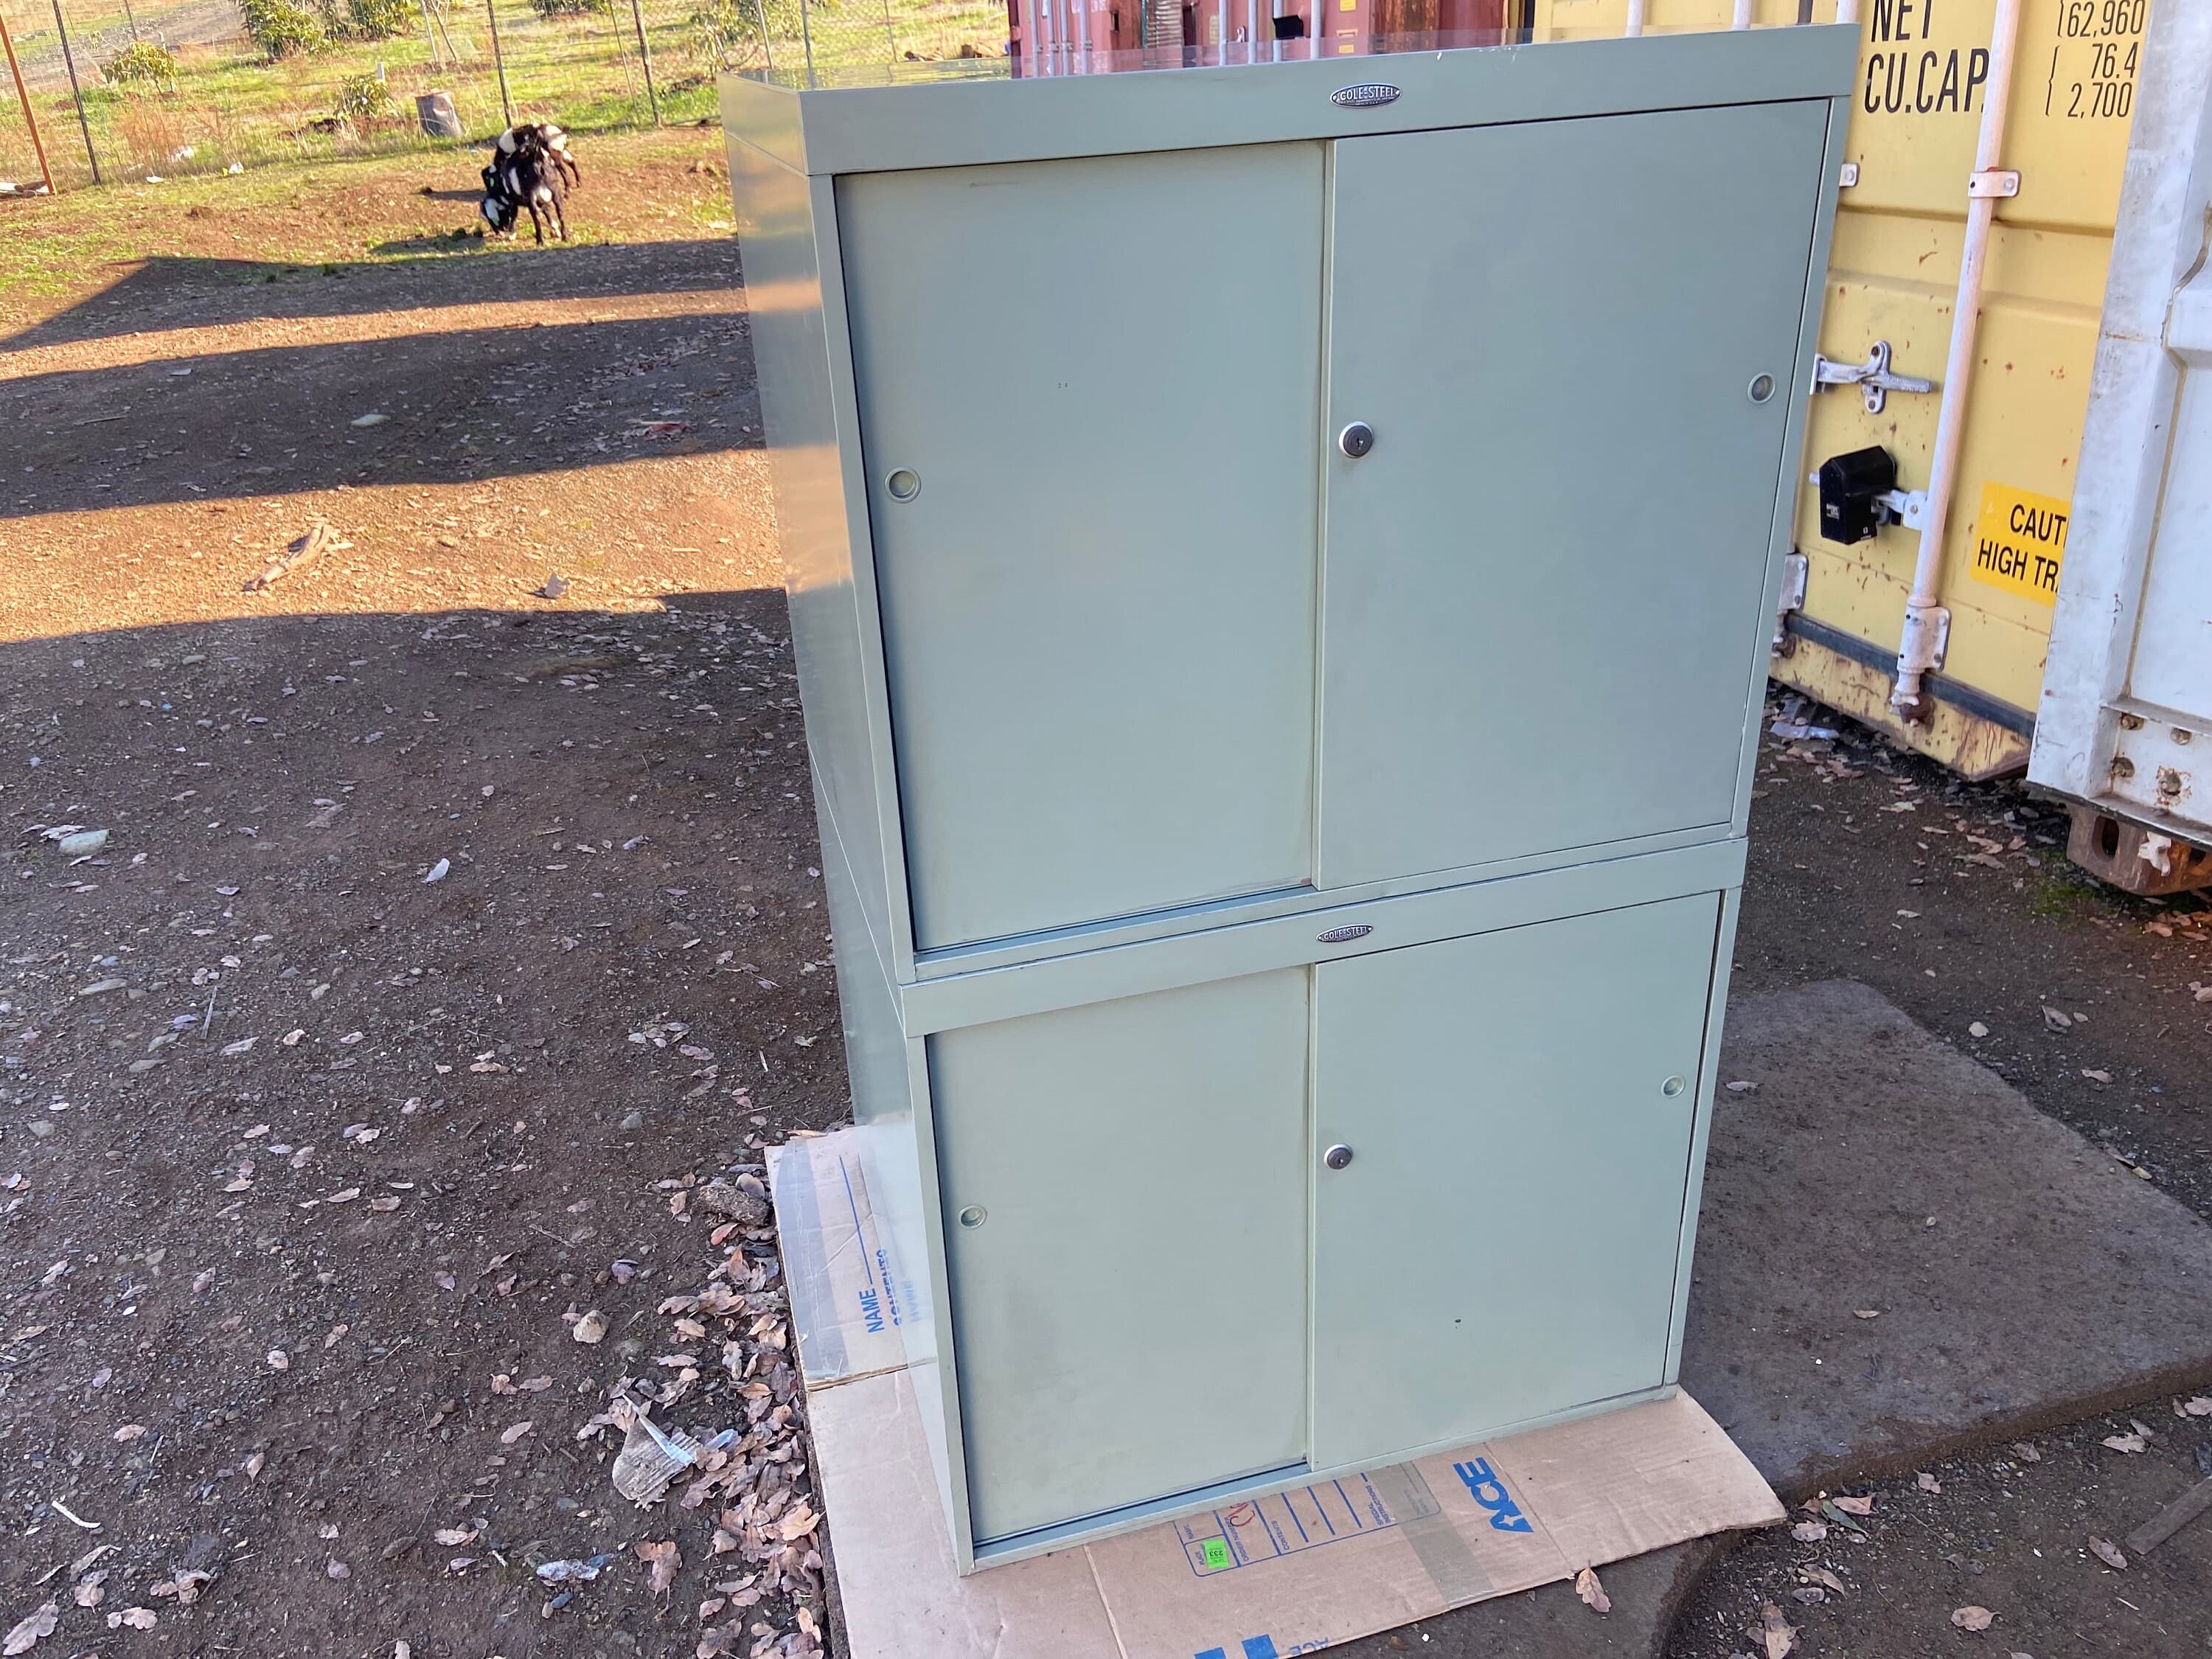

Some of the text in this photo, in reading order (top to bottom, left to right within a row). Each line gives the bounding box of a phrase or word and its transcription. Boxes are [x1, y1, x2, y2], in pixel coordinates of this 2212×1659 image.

[2067, 0, 2145, 38] 62,960
[2091, 42, 2138, 79] 76.4
[2067, 82, 2132, 119] 2,700
[2010, 504, 2070, 549] CAUT
[1978, 538, 2059, 593] HIGH TR
[859, 1288, 885, 1334] NAME
[1453, 1457, 1534, 1533] ACE
[1208, 1549, 1224, 1557] 233
